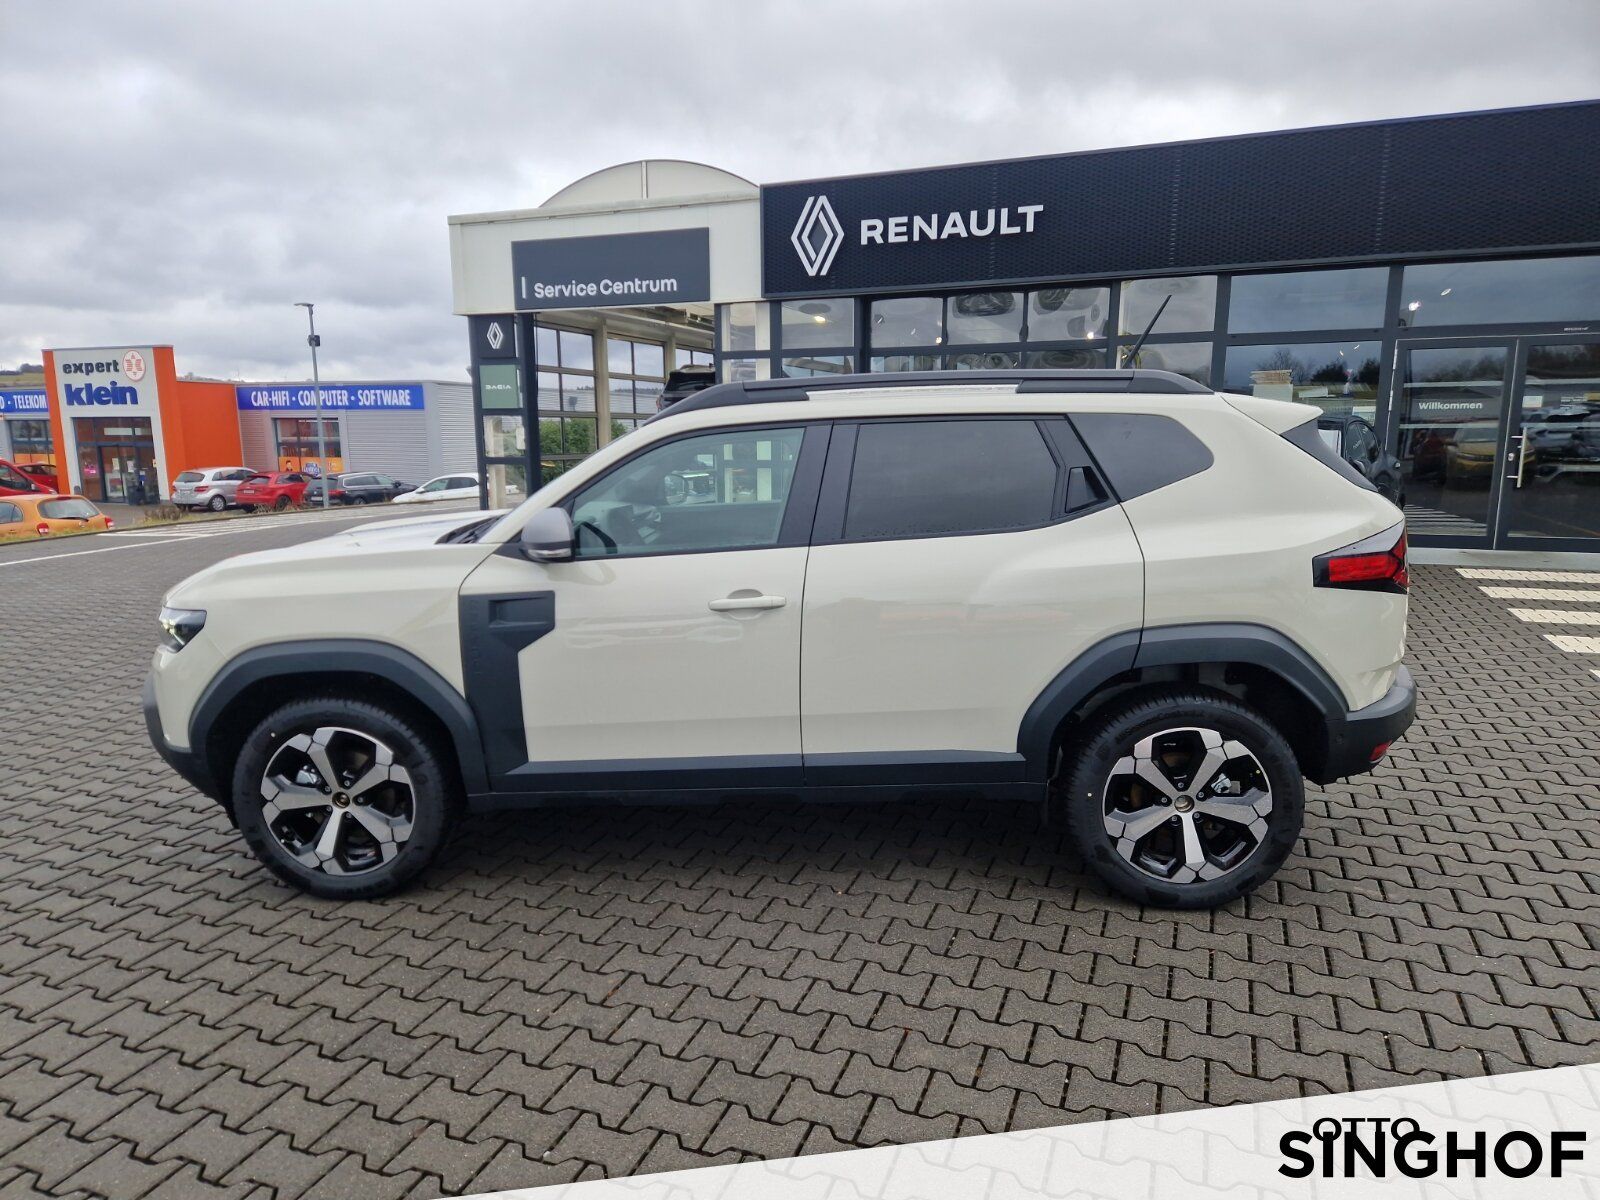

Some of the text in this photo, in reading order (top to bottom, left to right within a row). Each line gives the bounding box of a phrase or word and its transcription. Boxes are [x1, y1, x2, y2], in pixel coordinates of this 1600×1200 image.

[860, 204, 1044, 245] RENAULT
[533, 277, 678, 299] Service Centrum
[62, 359, 120, 376] expert
[12, 394, 48, 409] TELEKOM
[64, 380, 138, 406] klein
[358, 389, 411, 406] SOFTWARE
[1418, 401, 1483, 410] Willkommen
